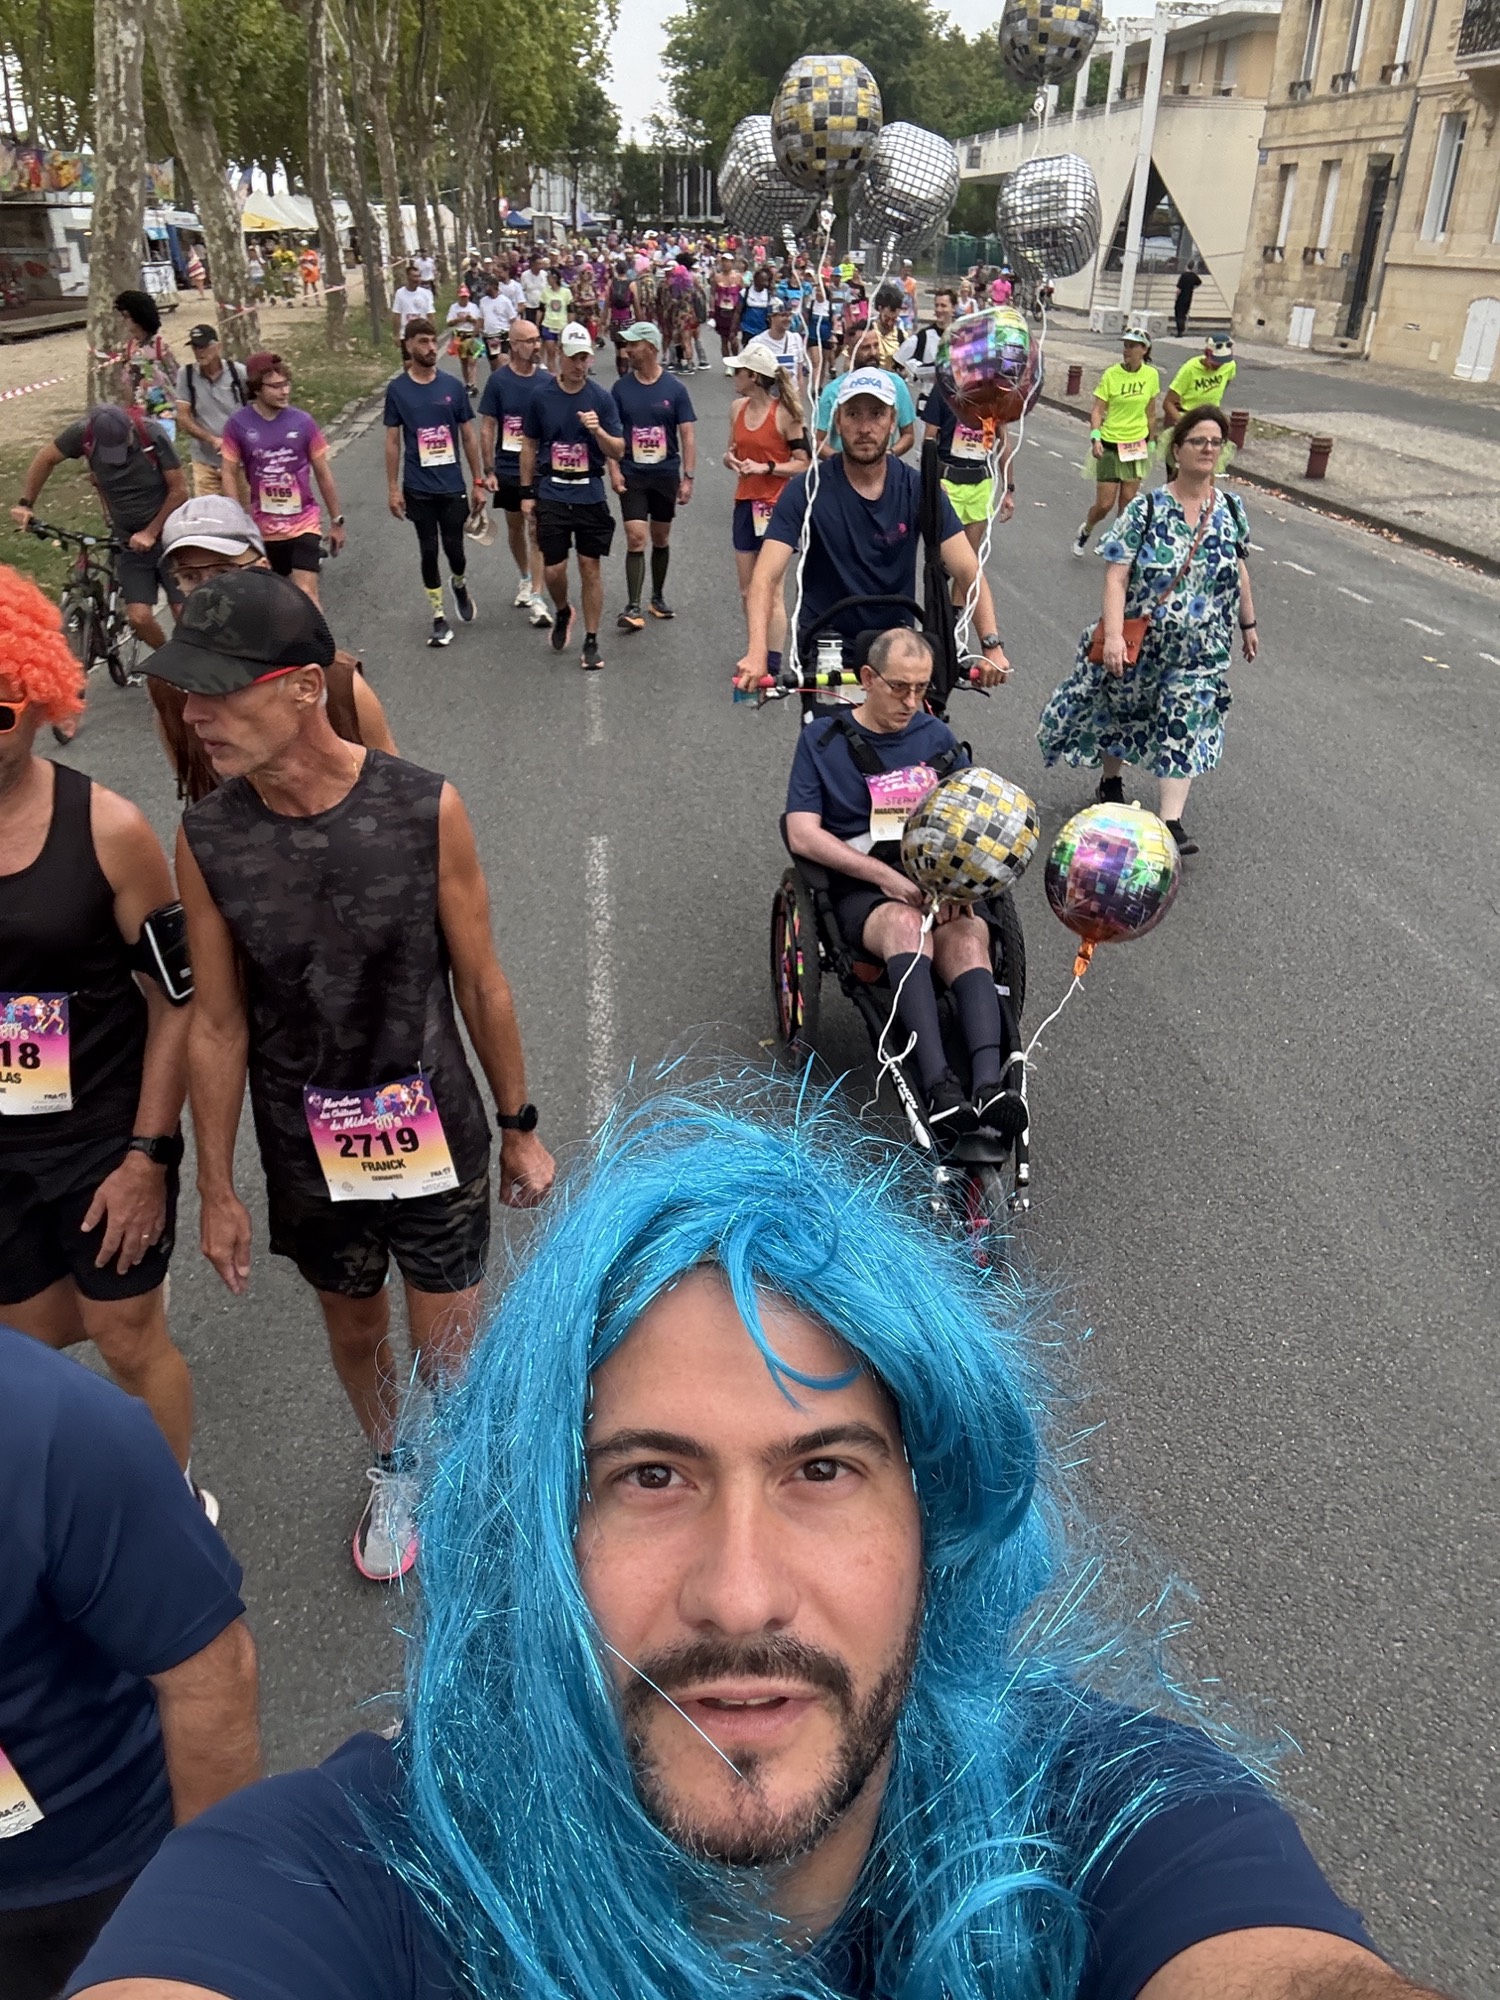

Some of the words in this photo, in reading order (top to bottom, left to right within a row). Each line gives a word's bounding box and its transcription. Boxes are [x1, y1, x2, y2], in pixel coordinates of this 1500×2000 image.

[849, 377, 882, 389] HOKA
[1121, 381, 1146, 395] LILY
[558, 456, 581, 468] 7341
[335, 1127, 420, 1159] 2719
[361, 1159, 407, 1172] FRANCK
